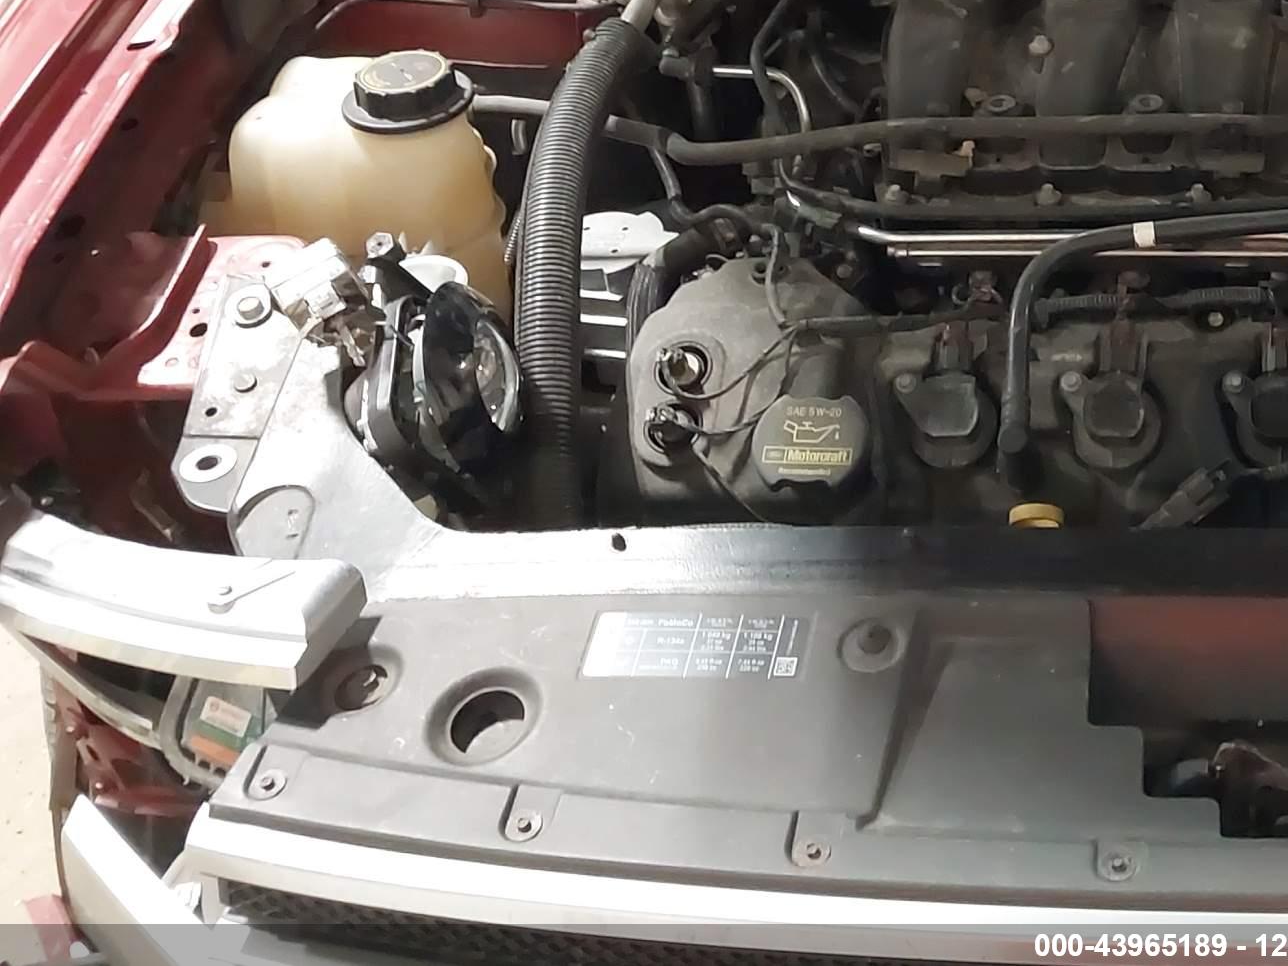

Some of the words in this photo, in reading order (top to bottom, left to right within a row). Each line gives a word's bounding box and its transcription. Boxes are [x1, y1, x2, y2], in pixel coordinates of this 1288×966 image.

[786, 405, 807, 417] SAE
[808, 406, 842, 418] 5W-20
[787, 449, 848, 463] Motorcraft
